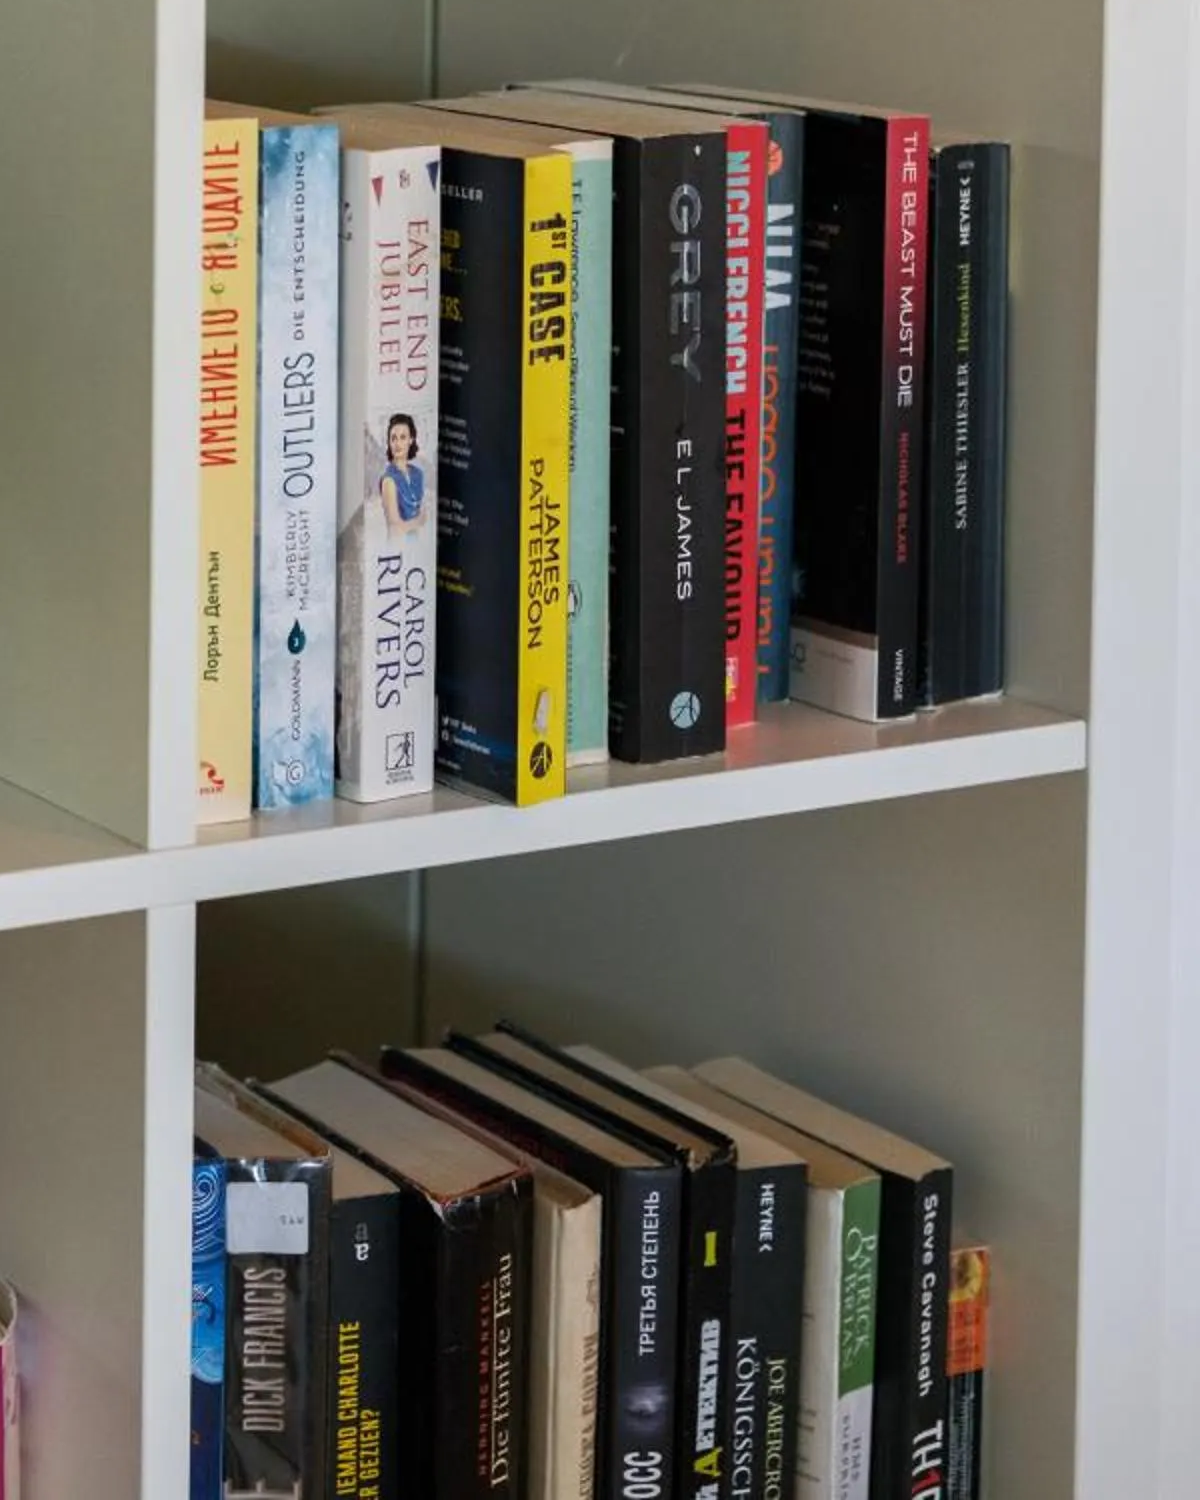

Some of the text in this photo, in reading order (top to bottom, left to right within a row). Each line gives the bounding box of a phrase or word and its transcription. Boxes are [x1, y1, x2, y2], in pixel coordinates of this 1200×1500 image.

[293, 150, 307, 341] DIE ENTSCHEIDUNG
[375, 241, 403, 376] JUBILEE
[406, 219, 430, 393] EAST END
[528, 212, 568, 367] 1ST CASE
[667, 183, 703, 382] GREY
[896, 131, 919, 407] THE BEAST MUST DIE
[956, 262, 972, 352] Hexenkind
[726, 257, 749, 394] FRENCH
[283, 351, 316, 498] OUTLIERS
[896, 432, 909, 564] NICHOLAS BLAKE
[954, 362, 970, 530] SABINE THIESLER
[286, 509, 298, 598] KIMBERLY
[298, 509, 312, 611] McCREIGHT
[525, 458, 545, 650] PATTERSON
[542, 494, 561, 606] JAMES
[675, 440, 692, 601] E L JAMES
[202, 550, 225, 684] Лорън Дентън
[375, 553, 403, 710] RIVERS
[402, 566, 427, 690] CAROL
[892, 649, 903, 702] VINTAGE
[292, 659, 304, 741] GOLDMANN
[242, 1266, 287, 1432] DICK FRANCIS
[638, 1191, 660, 1356] ТРЕТЬЯ СТЕПЕНЬ
[855, 1235, 879, 1352] PATRICK
[917, 1193, 938, 1397] Steve Cavanagh
[337, 1320, 360, 1494] IEMAND CHARLOTTE
[359, 1409, 380, 1479] GEZIEN?
[478, 1280, 491, 1476] HENNING MANKELL
[491, 1252, 512, 1488] Die fünfte Frau
[693, 1319, 722, 1477] ДЕТЕКТИВ
[765, 1358, 786, 1394] JOE
